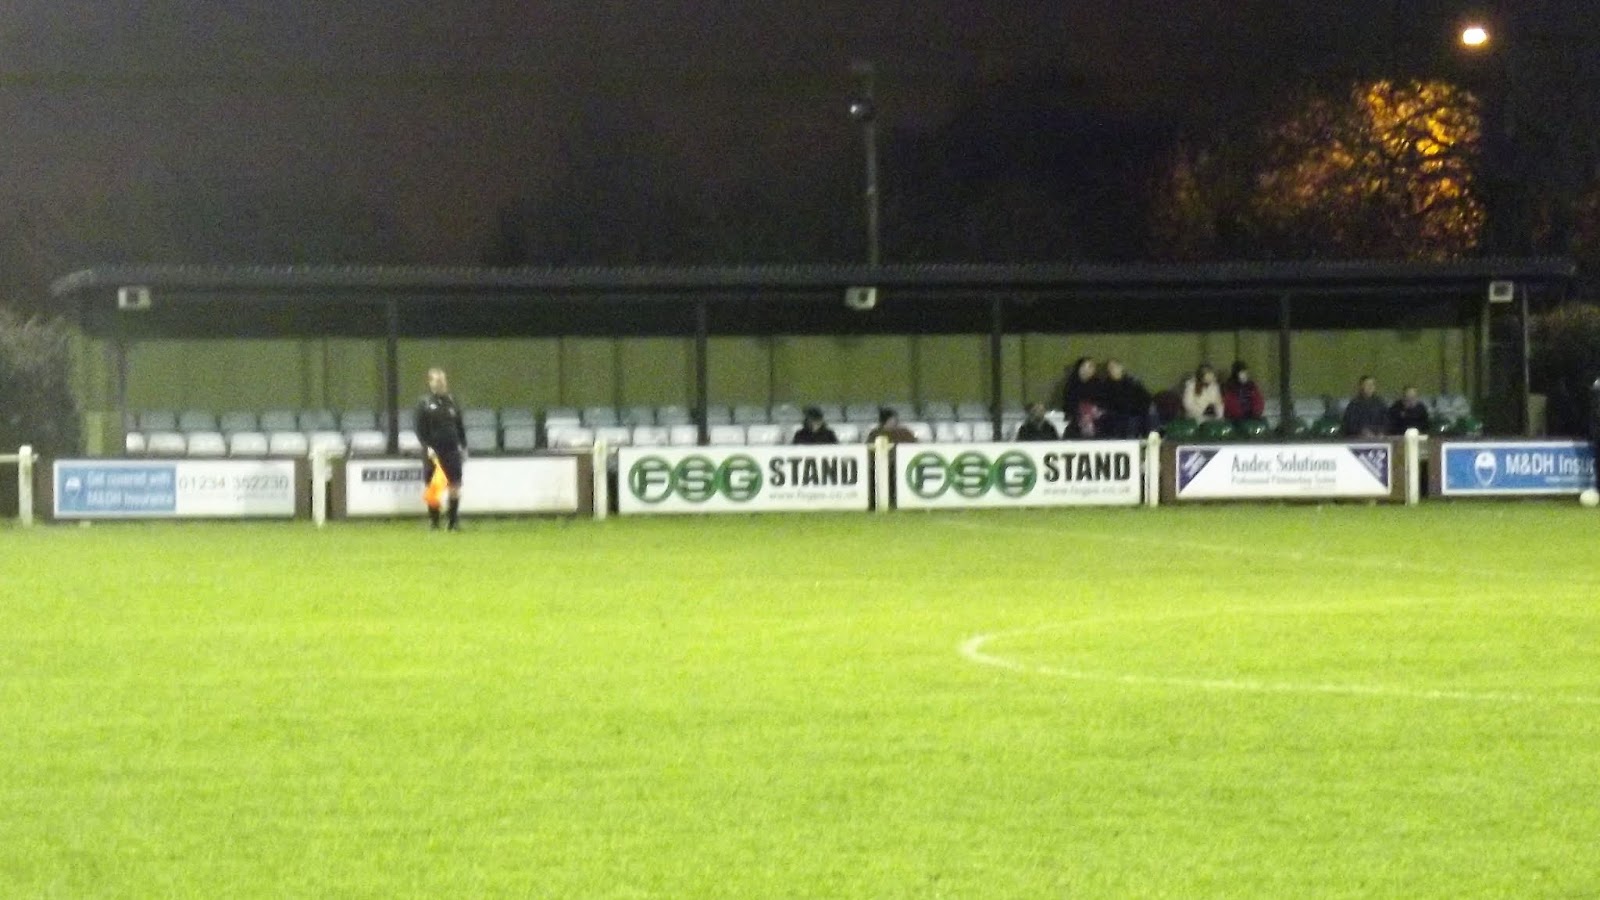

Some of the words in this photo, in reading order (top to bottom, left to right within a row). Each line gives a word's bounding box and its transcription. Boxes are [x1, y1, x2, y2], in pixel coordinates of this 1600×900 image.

[1276, 453, 1336, 472] Solutions
[1505, 453, 1555, 476] M&DH
[179, 476, 226, 489] 01234
[629, 455, 763, 503] FSG
[769, 457, 858, 486] STAND
[906, 450, 1037, 499] FSG
[1043, 453, 1130, 482] STAND
